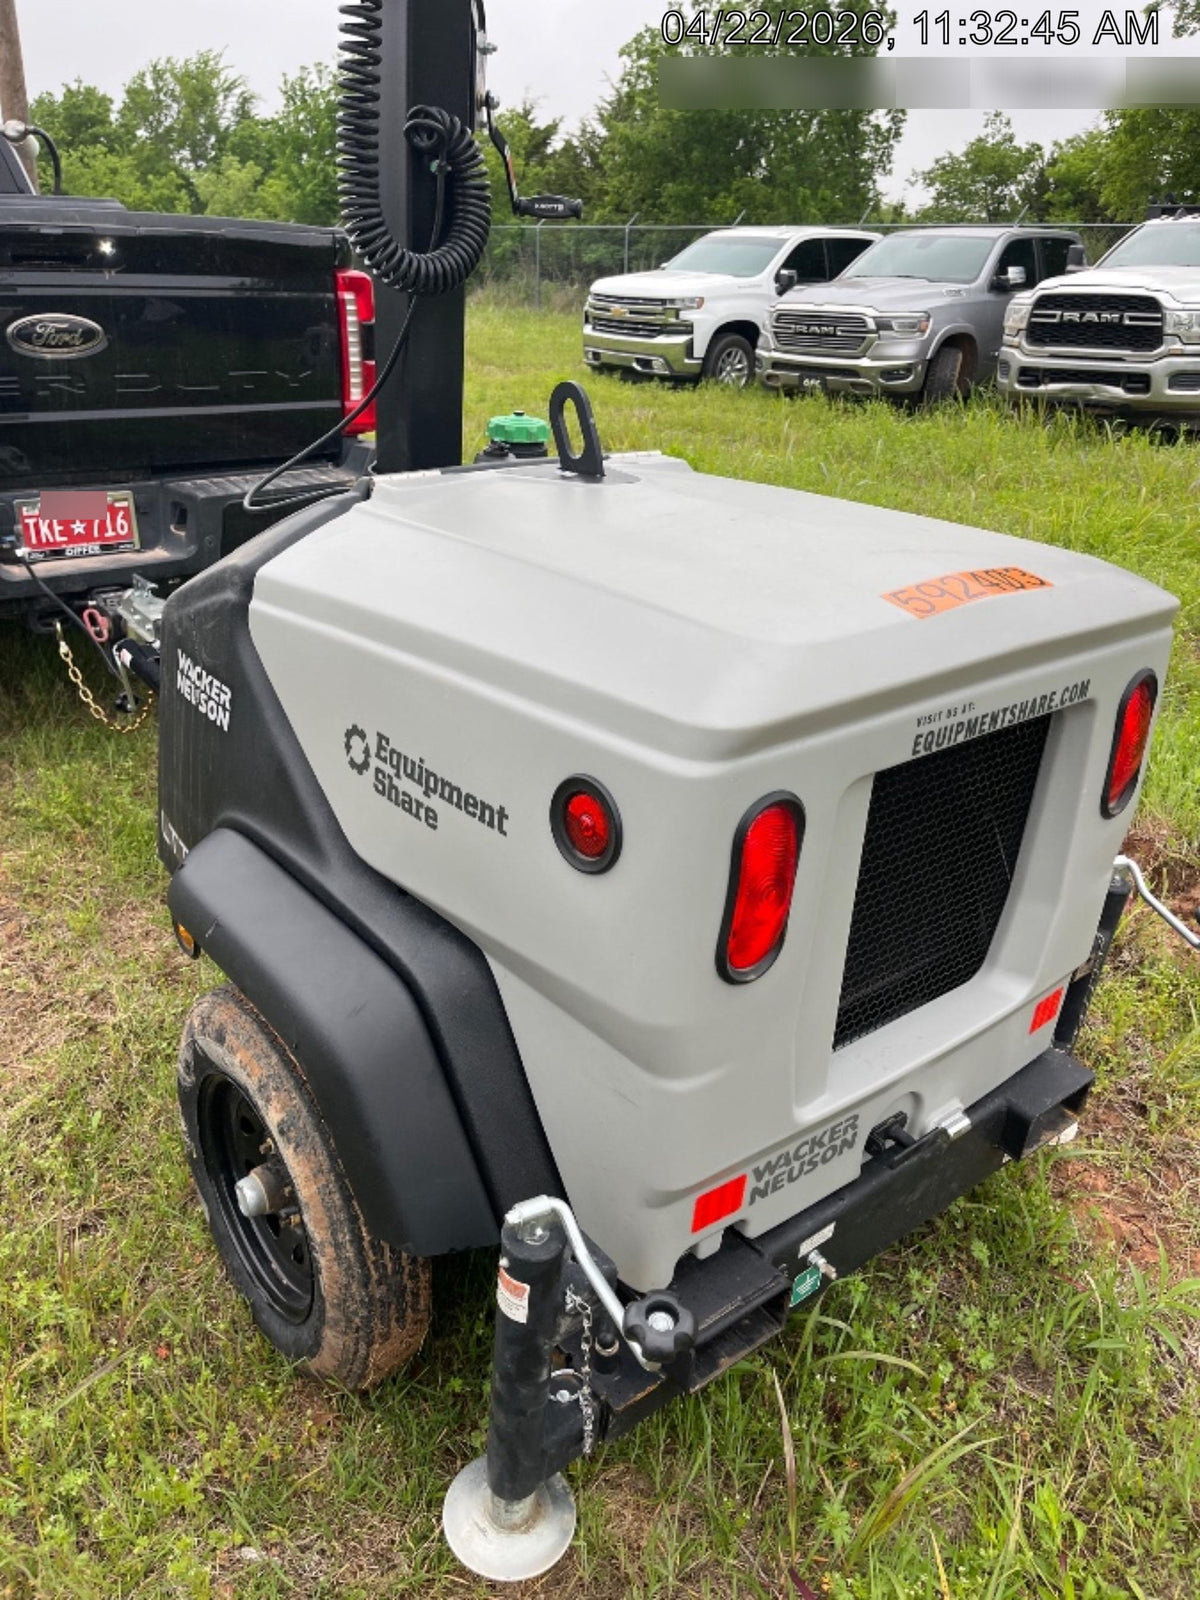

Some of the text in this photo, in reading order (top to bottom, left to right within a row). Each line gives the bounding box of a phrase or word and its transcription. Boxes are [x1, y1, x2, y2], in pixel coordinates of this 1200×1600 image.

[31, 322, 84, 346] Ford
[793, 323, 836, 336] RAM
[1062, 311, 1120, 324] RAM
[176, 647, 232, 713] WACKER
[176, 669, 230, 733] NEUSON
[911, 678, 1092, 757] EQUIPMENTSHARE.COM
[916, 710, 943, 728] VISIT
[372, 765, 439, 831] Share
[374, 730, 509, 838] Equipment
[747, 1131, 858, 1206] NEUSON
[751, 1113, 860, 1183] WACKER
